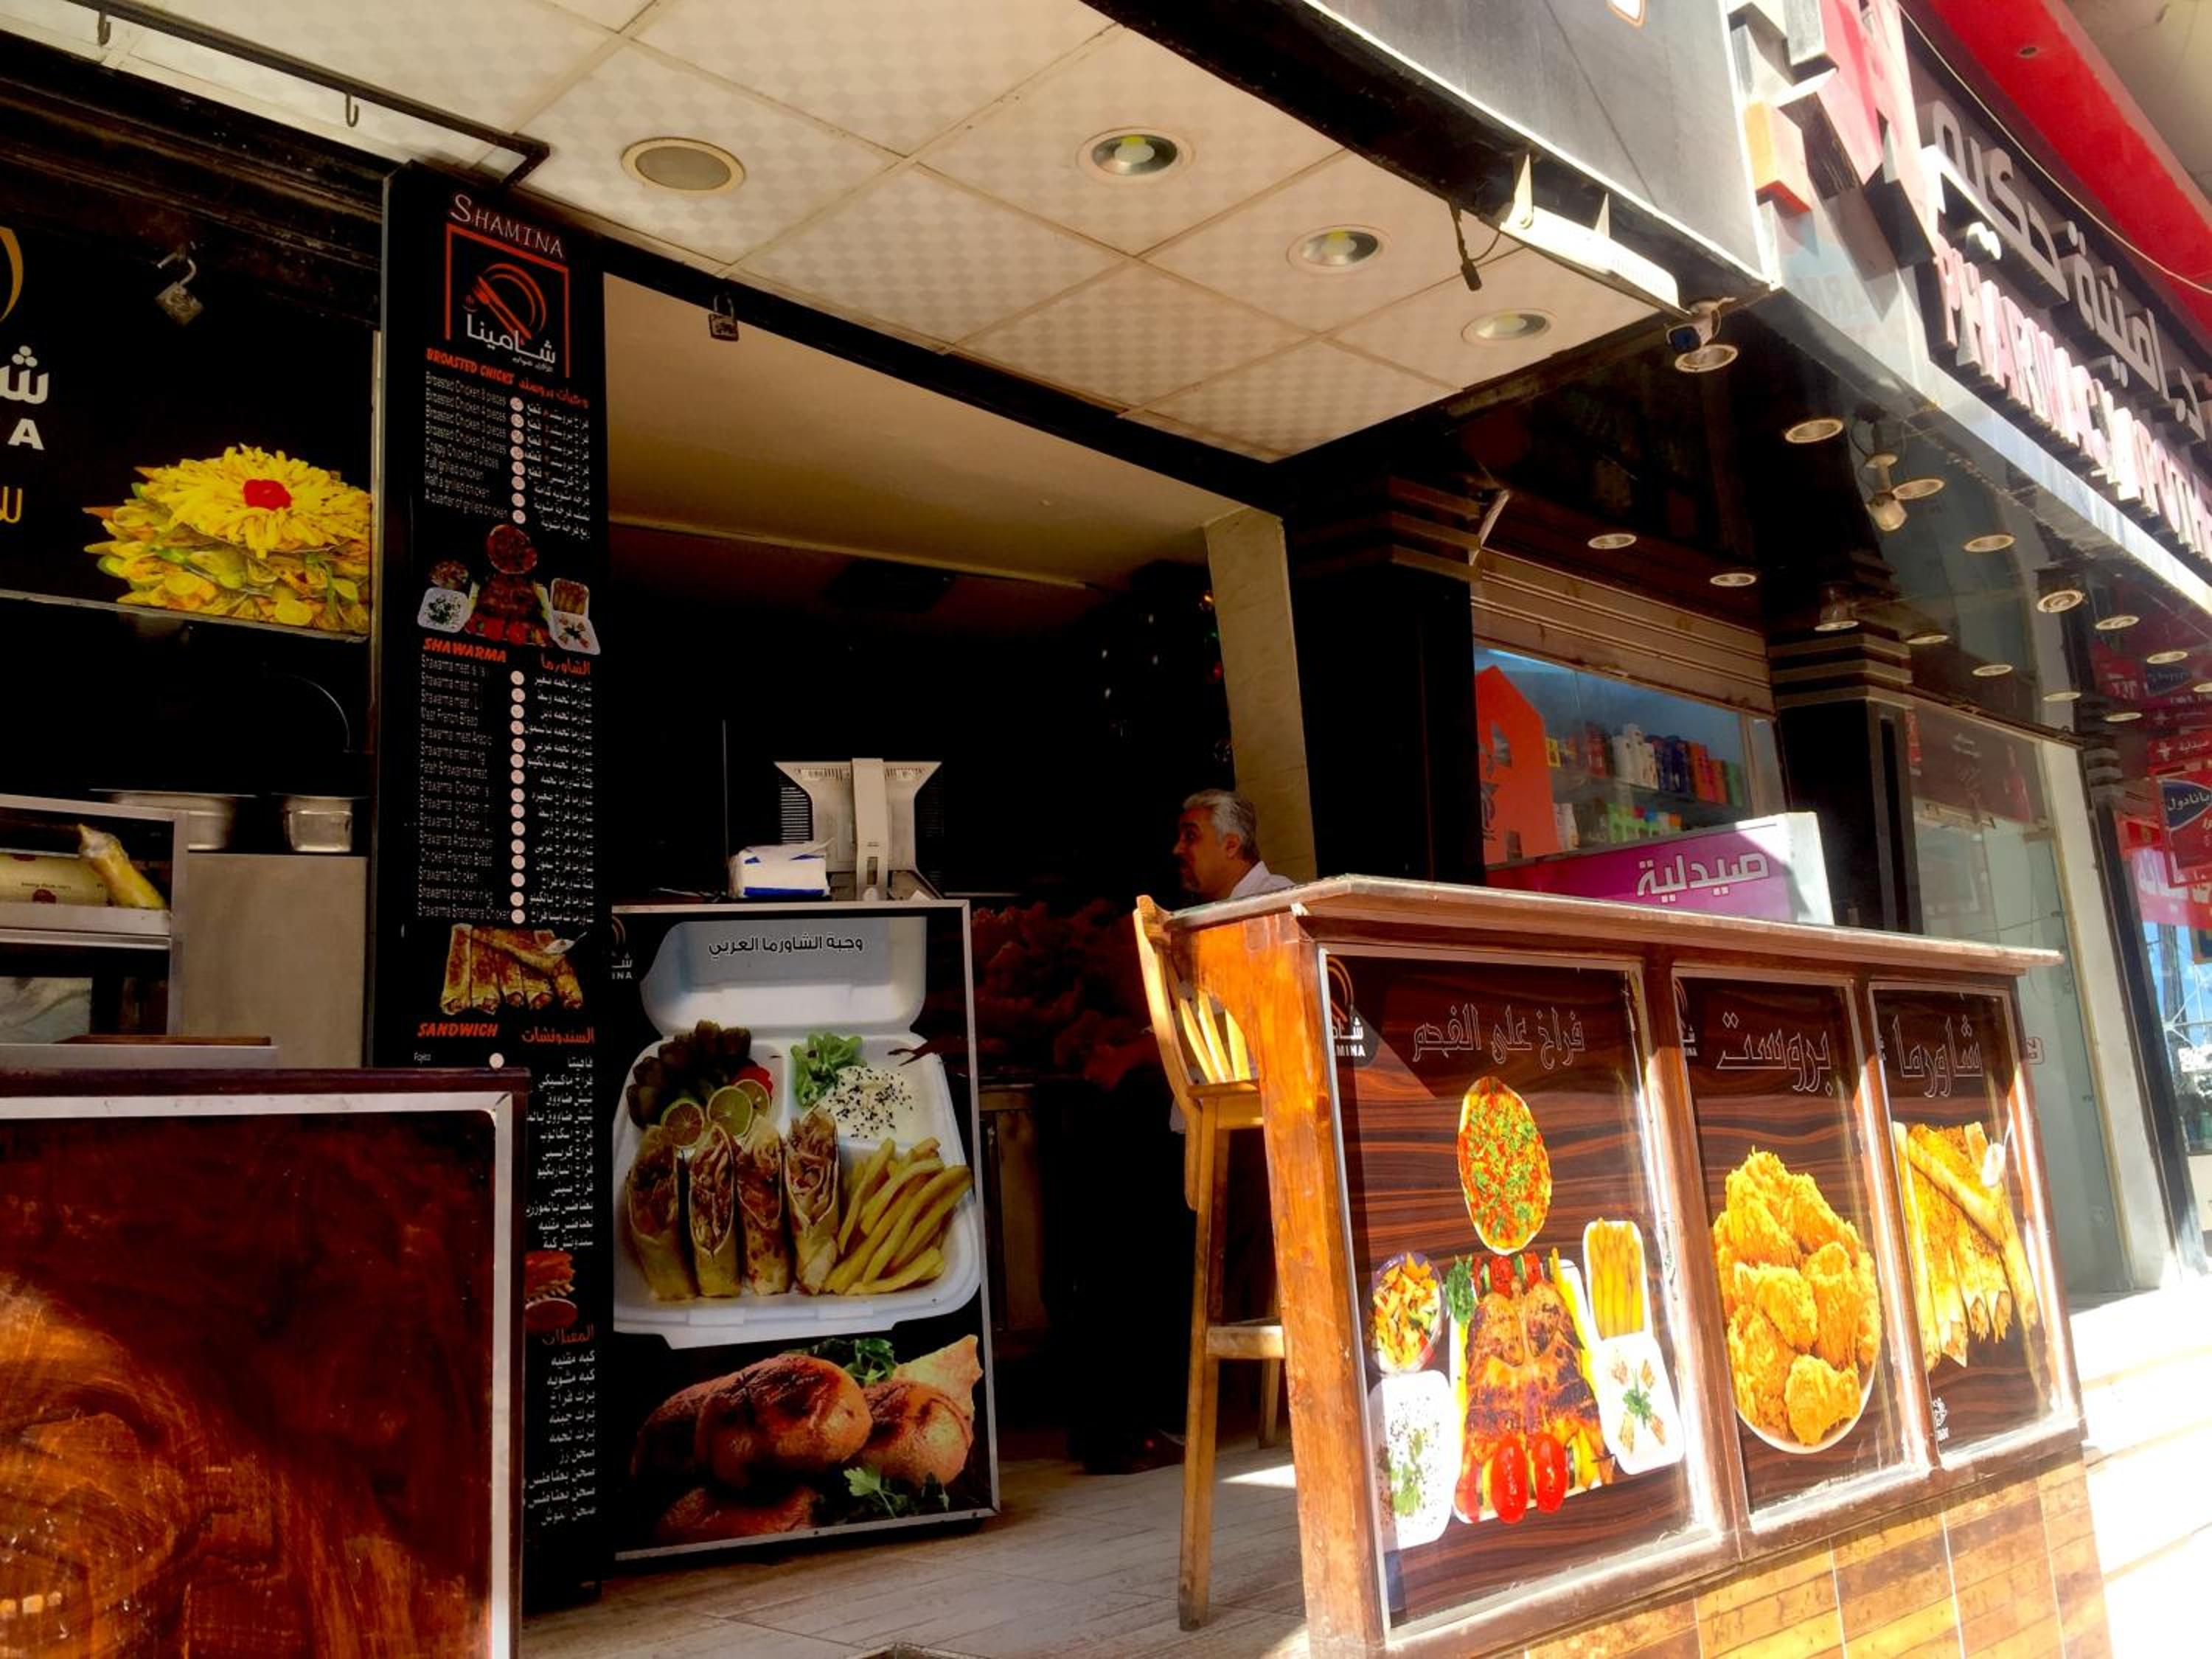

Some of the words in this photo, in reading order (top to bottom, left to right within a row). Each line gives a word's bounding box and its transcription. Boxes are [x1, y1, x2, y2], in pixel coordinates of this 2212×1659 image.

[450, 192, 565, 260] SHAMINA
[467, 312, 556, 366] شامينا
[422, 636, 507, 663] SHAWARMA
[1636, 852, 1770, 902] صيدلية
[709, 936, 759, 962] العربي
[762, 932, 824, 953] الشاورما
[827, 937, 863, 952] وجبة
[416, 1022, 499, 1038] SANDWICH
[1412, 1002, 1482, 1063] الفحم
[1491, 1004, 1534, 1065] على
[1537, 1006, 1586, 1073] فراخ
[1717, 1011, 1833, 1096] بروست
[1893, 1014, 1984, 1099] شاورما
